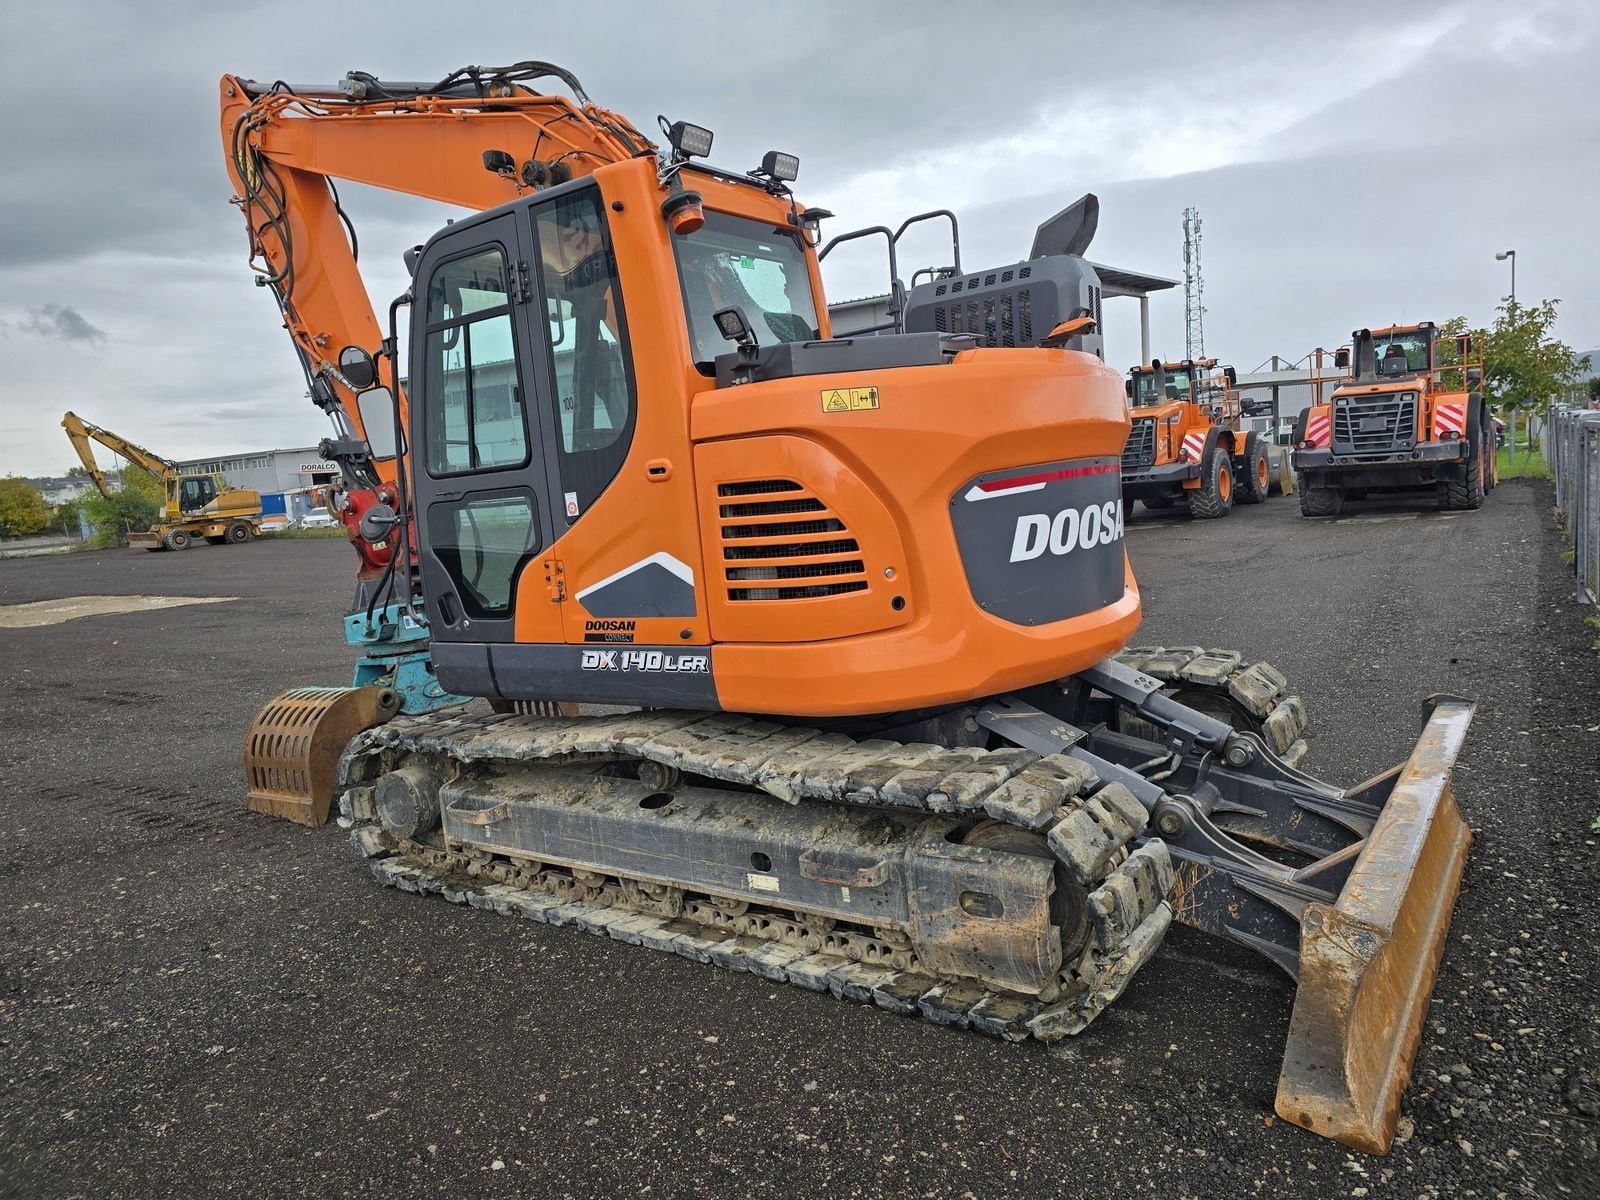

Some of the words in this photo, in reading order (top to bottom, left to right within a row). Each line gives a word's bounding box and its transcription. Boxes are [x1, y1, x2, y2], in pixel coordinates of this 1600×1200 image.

[585, 621, 636, 631] DOOSAN
[604, 633, 633, 642] CONNECT
[581, 650, 618, 671] DX
